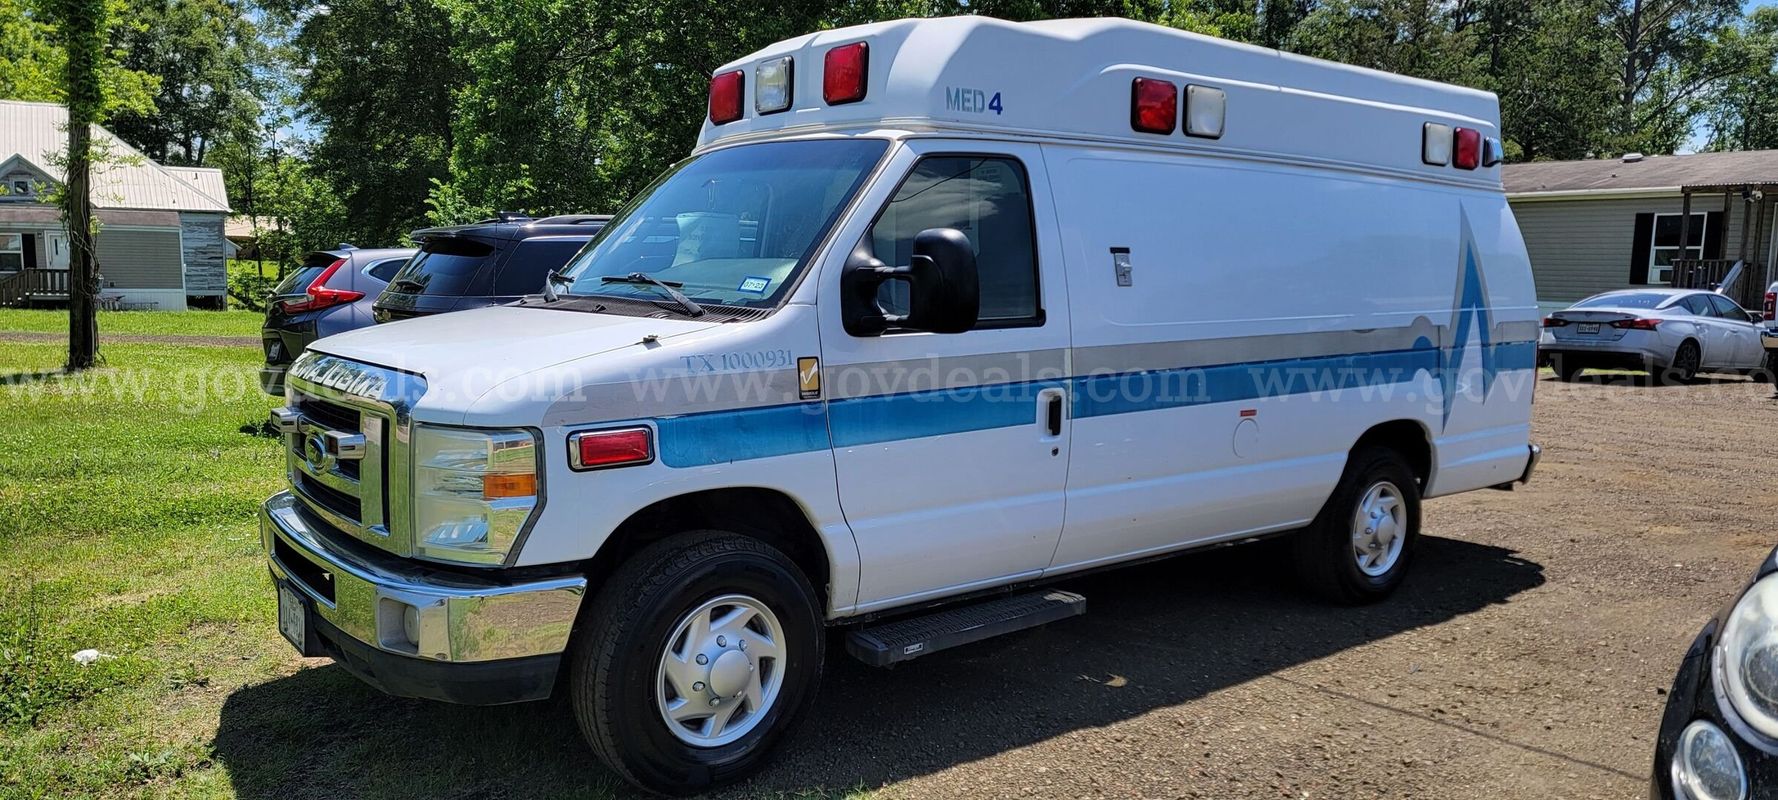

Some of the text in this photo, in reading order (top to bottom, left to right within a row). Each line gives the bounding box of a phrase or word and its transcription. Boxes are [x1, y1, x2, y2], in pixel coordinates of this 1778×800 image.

[945, 86, 1003, 115] MED 4
[680, 349, 794, 373] TX 1000931
